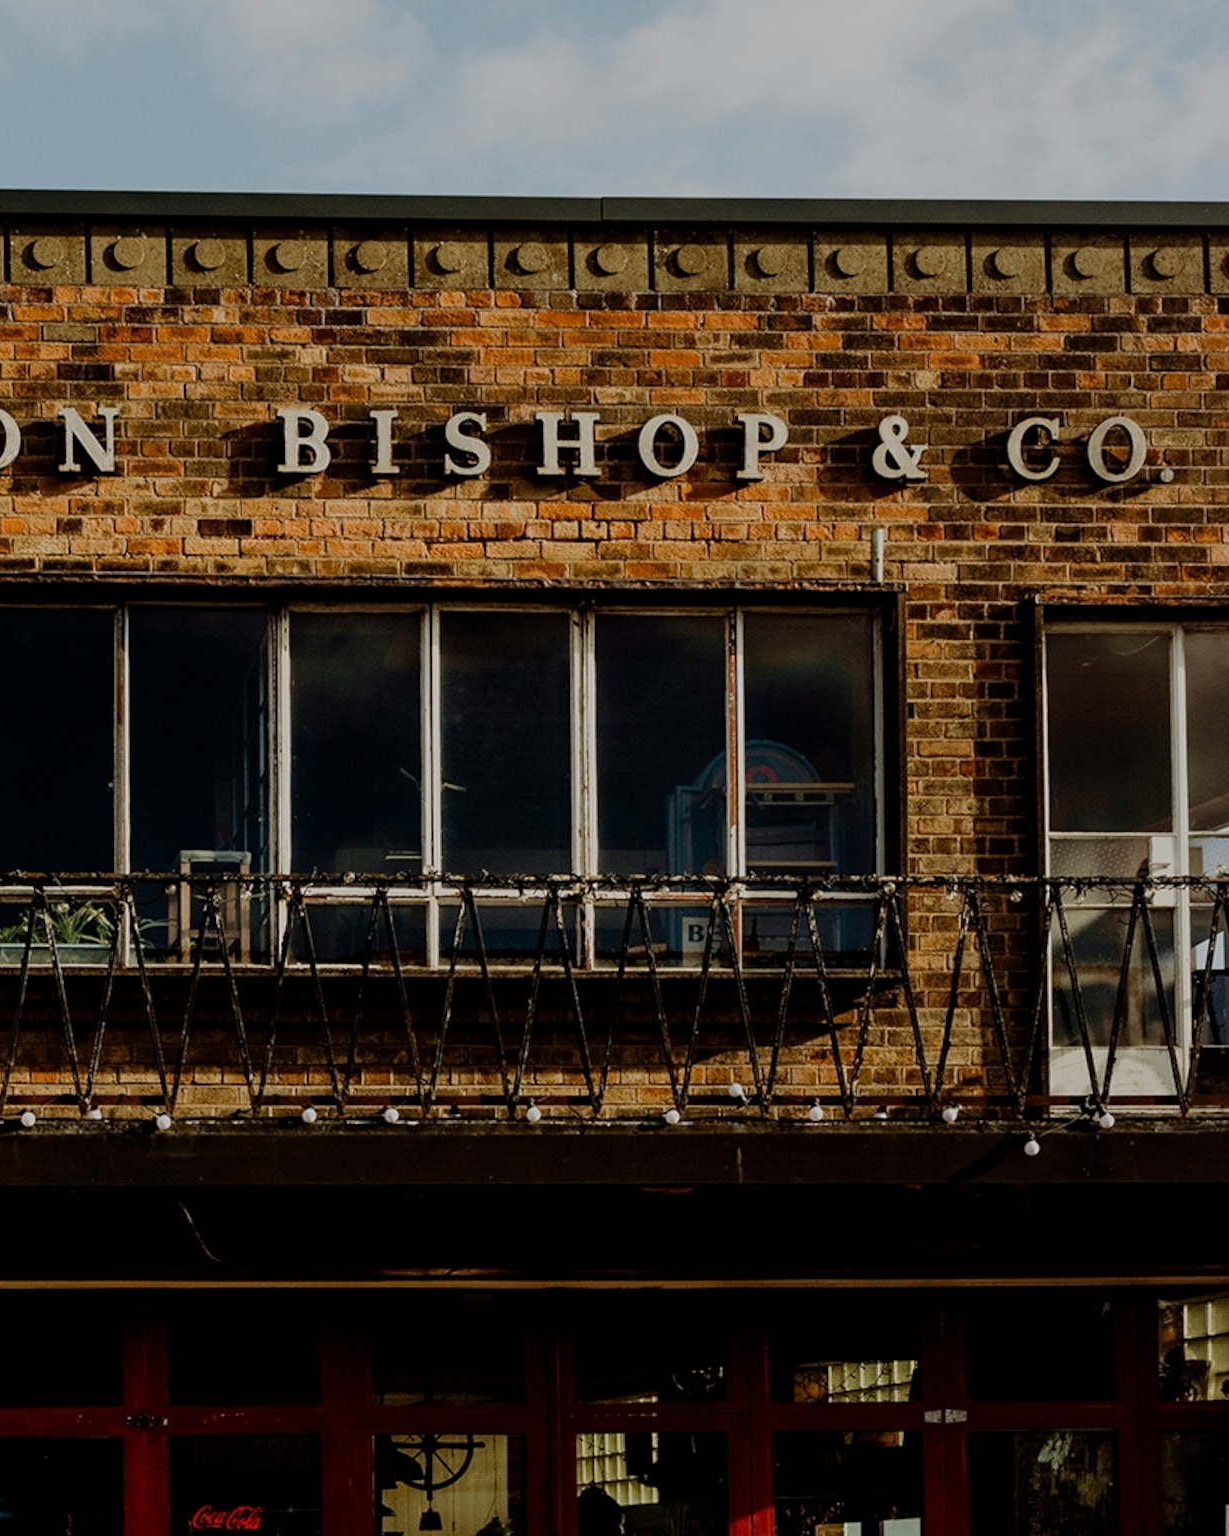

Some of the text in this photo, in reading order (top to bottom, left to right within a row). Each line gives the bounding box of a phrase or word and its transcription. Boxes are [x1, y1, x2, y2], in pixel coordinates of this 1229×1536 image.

[275, 409, 790, 480] BISHOP
[871, 415, 929, 481] &
[1007, 415, 1175, 483] CO.
